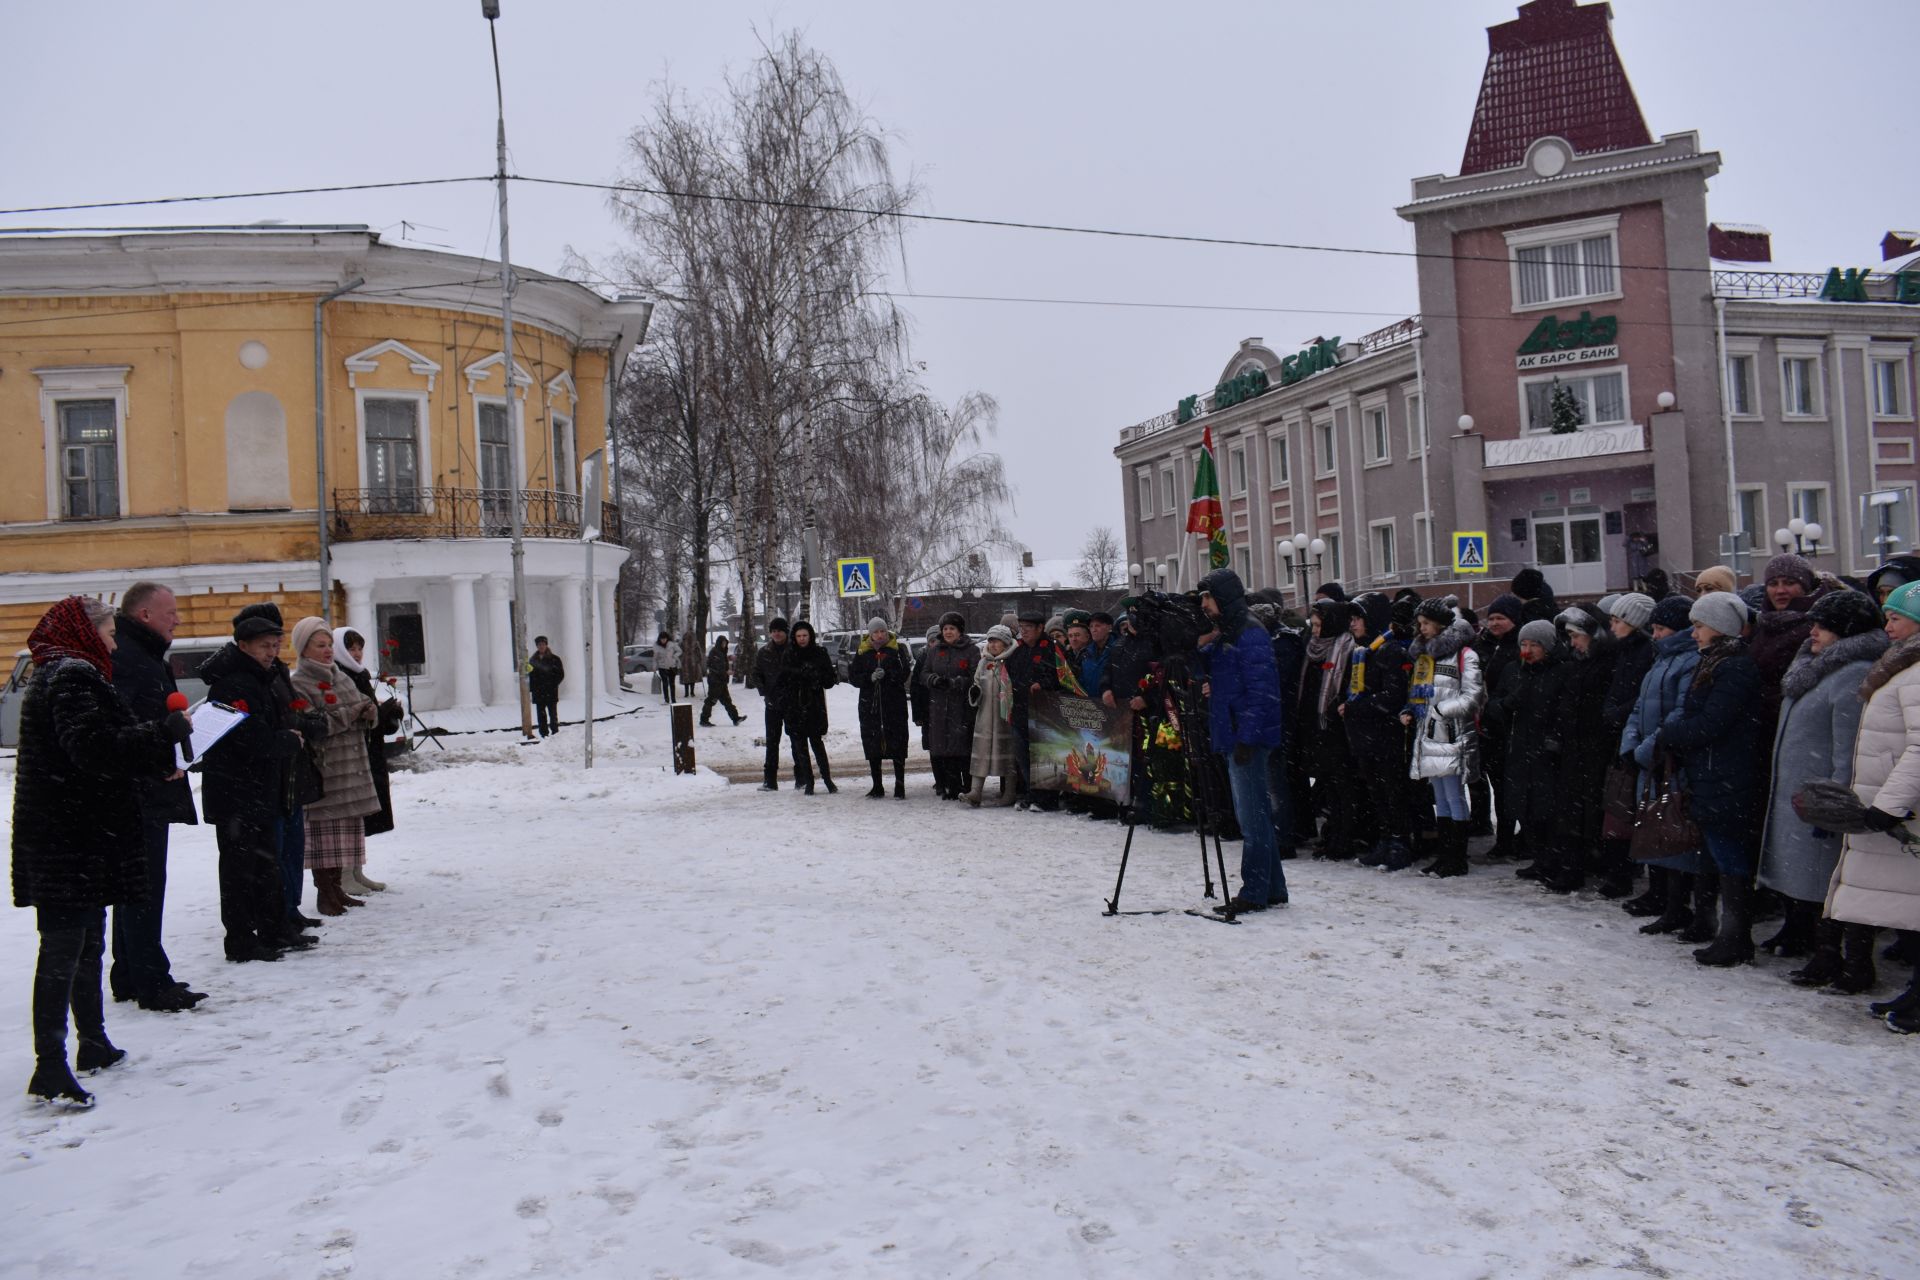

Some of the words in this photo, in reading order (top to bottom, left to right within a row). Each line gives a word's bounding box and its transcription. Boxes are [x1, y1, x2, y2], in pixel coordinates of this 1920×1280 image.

[1817, 267, 1871, 301] АК
[1518, 356, 1536, 367] АК
[1540, 352, 1577, 365] БАРС
[1580, 347, 1617, 360] БАНК
[1178, 394, 1198, 424] АК
[1215, 369, 1269, 410] БАРС
[1281, 336, 1342, 385] БАНК
